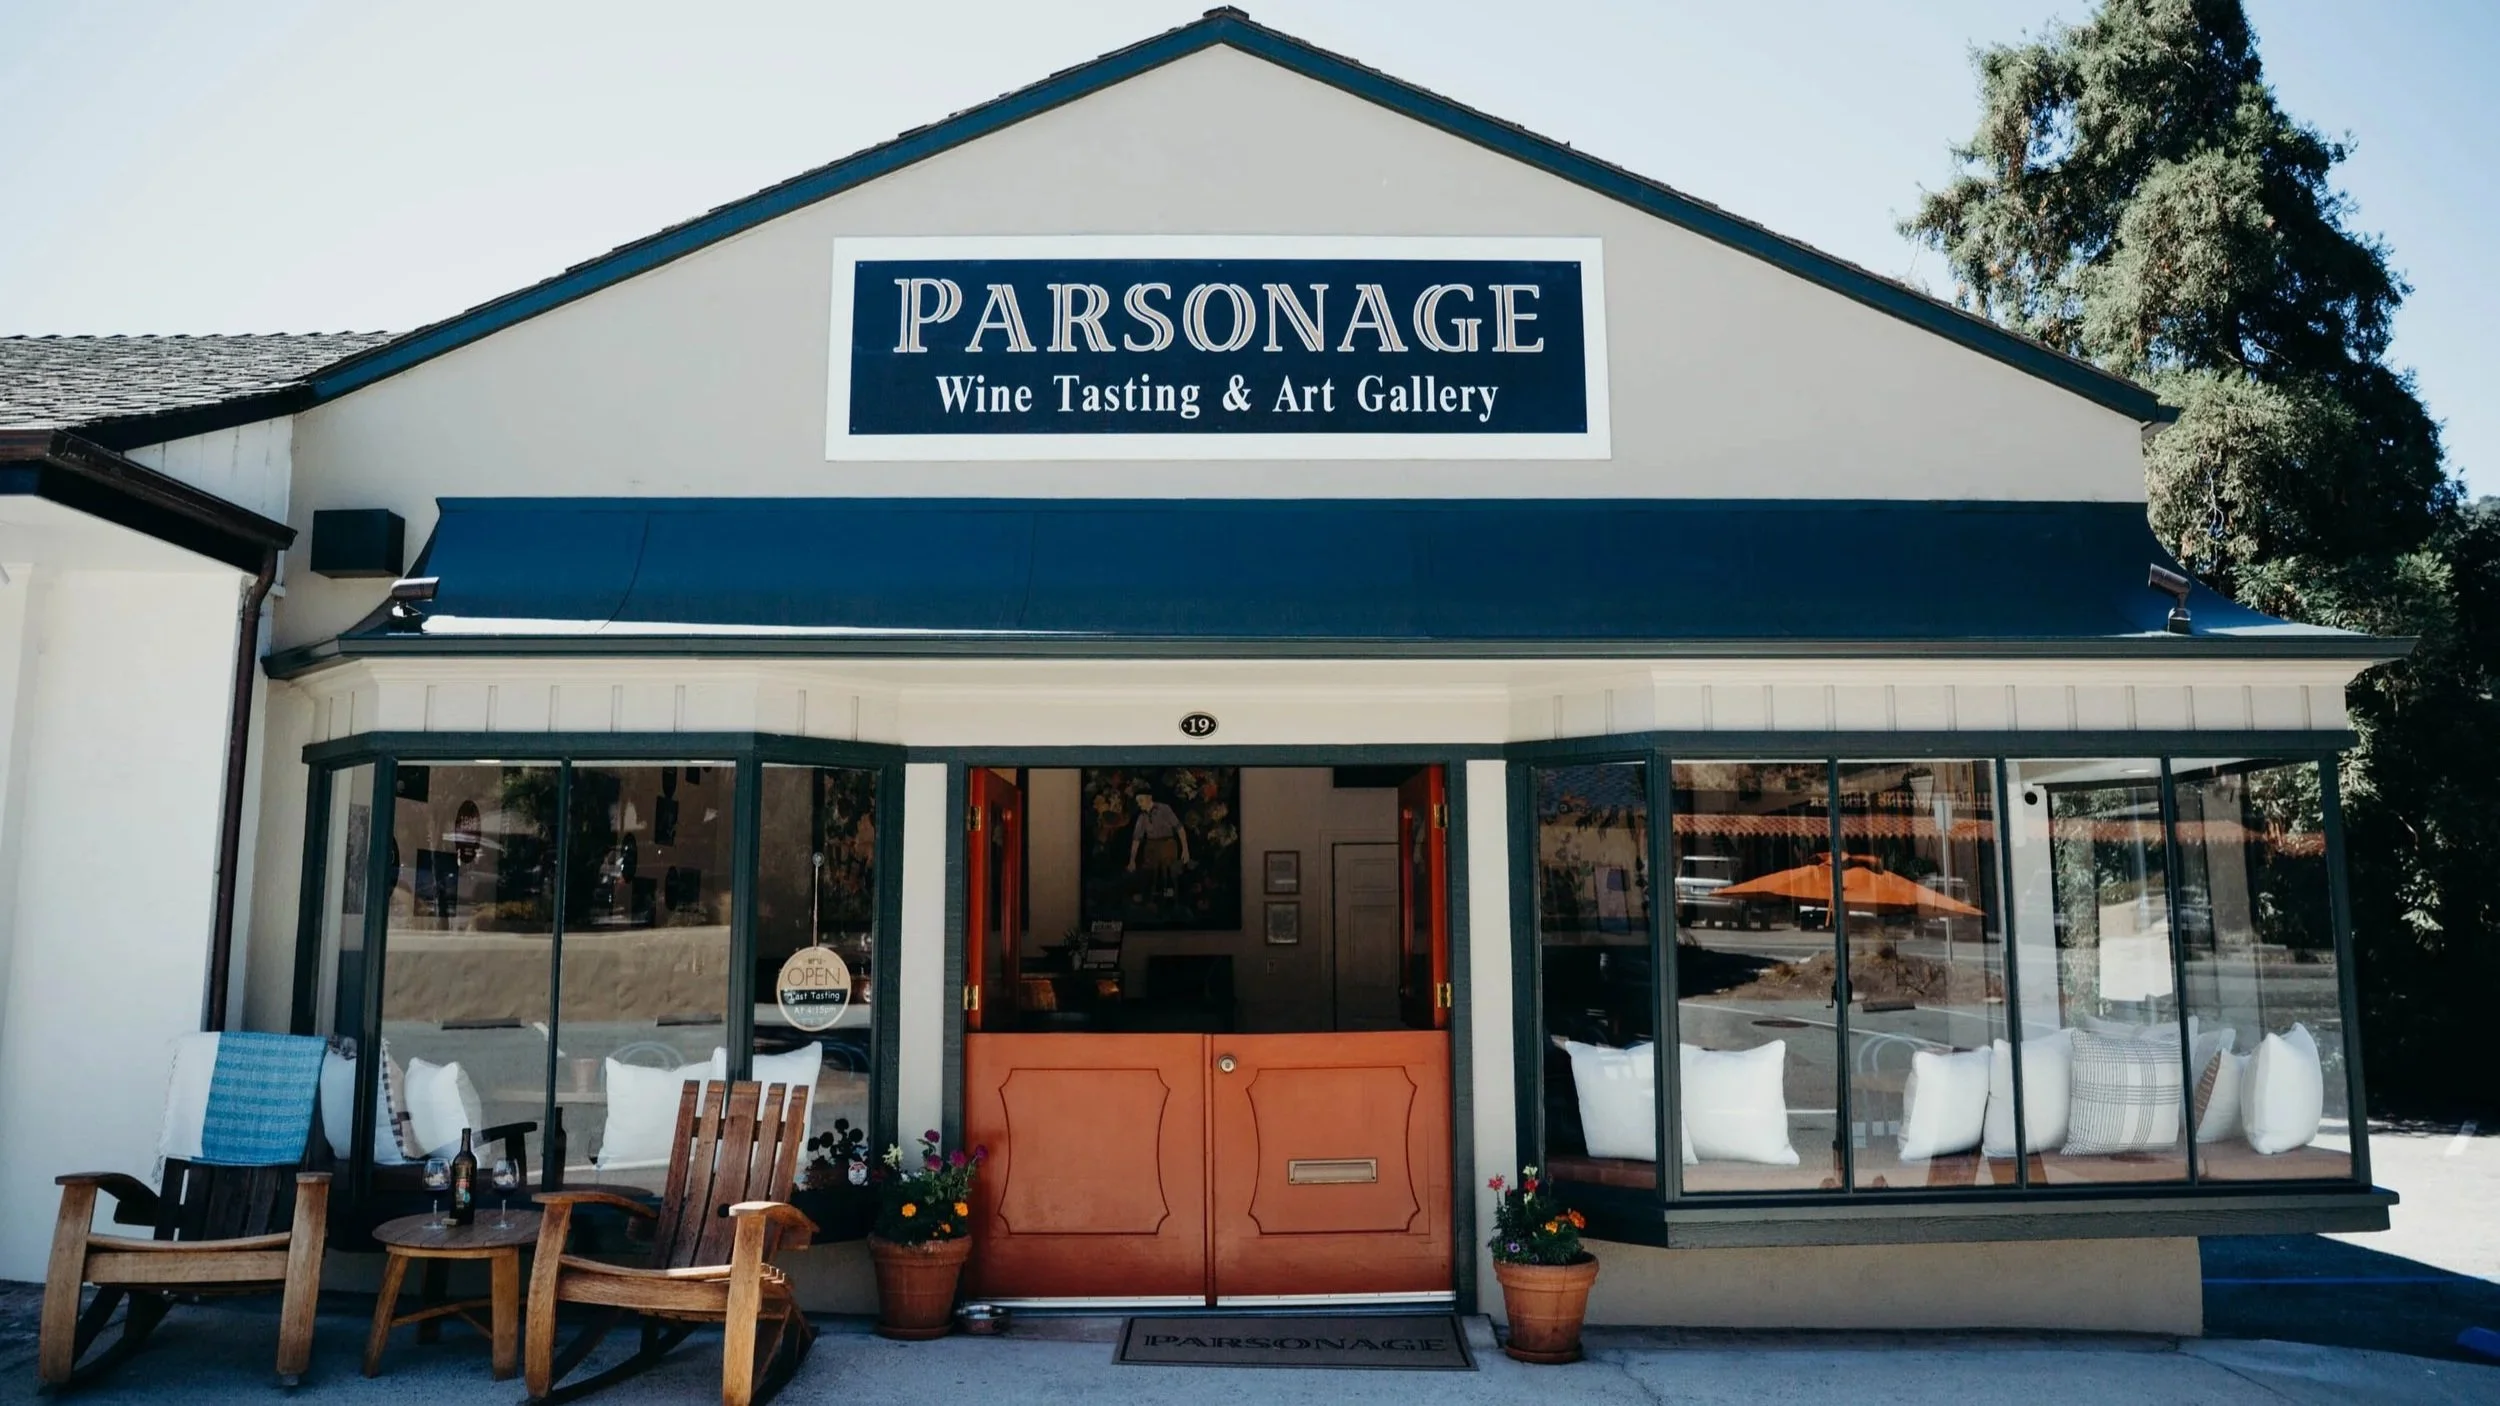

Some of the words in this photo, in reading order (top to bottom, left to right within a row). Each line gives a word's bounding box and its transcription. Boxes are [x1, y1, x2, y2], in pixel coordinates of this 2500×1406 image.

[893, 277, 1545, 354] PARSONAGE
[936, 374, 1033, 414] Wine
[1053, 373, 1200, 419] Tasting
[1222, 374, 1252, 412] &
[1273, 374, 1336, 413] Art
[1357, 374, 1499, 422] Gallery
[1189, 718, 1210, 733] 19
[787, 967, 841, 987] OPEN
[810, 991, 840, 1002] Tasting
[1144, 1334, 1447, 1352] PARSONAGE
